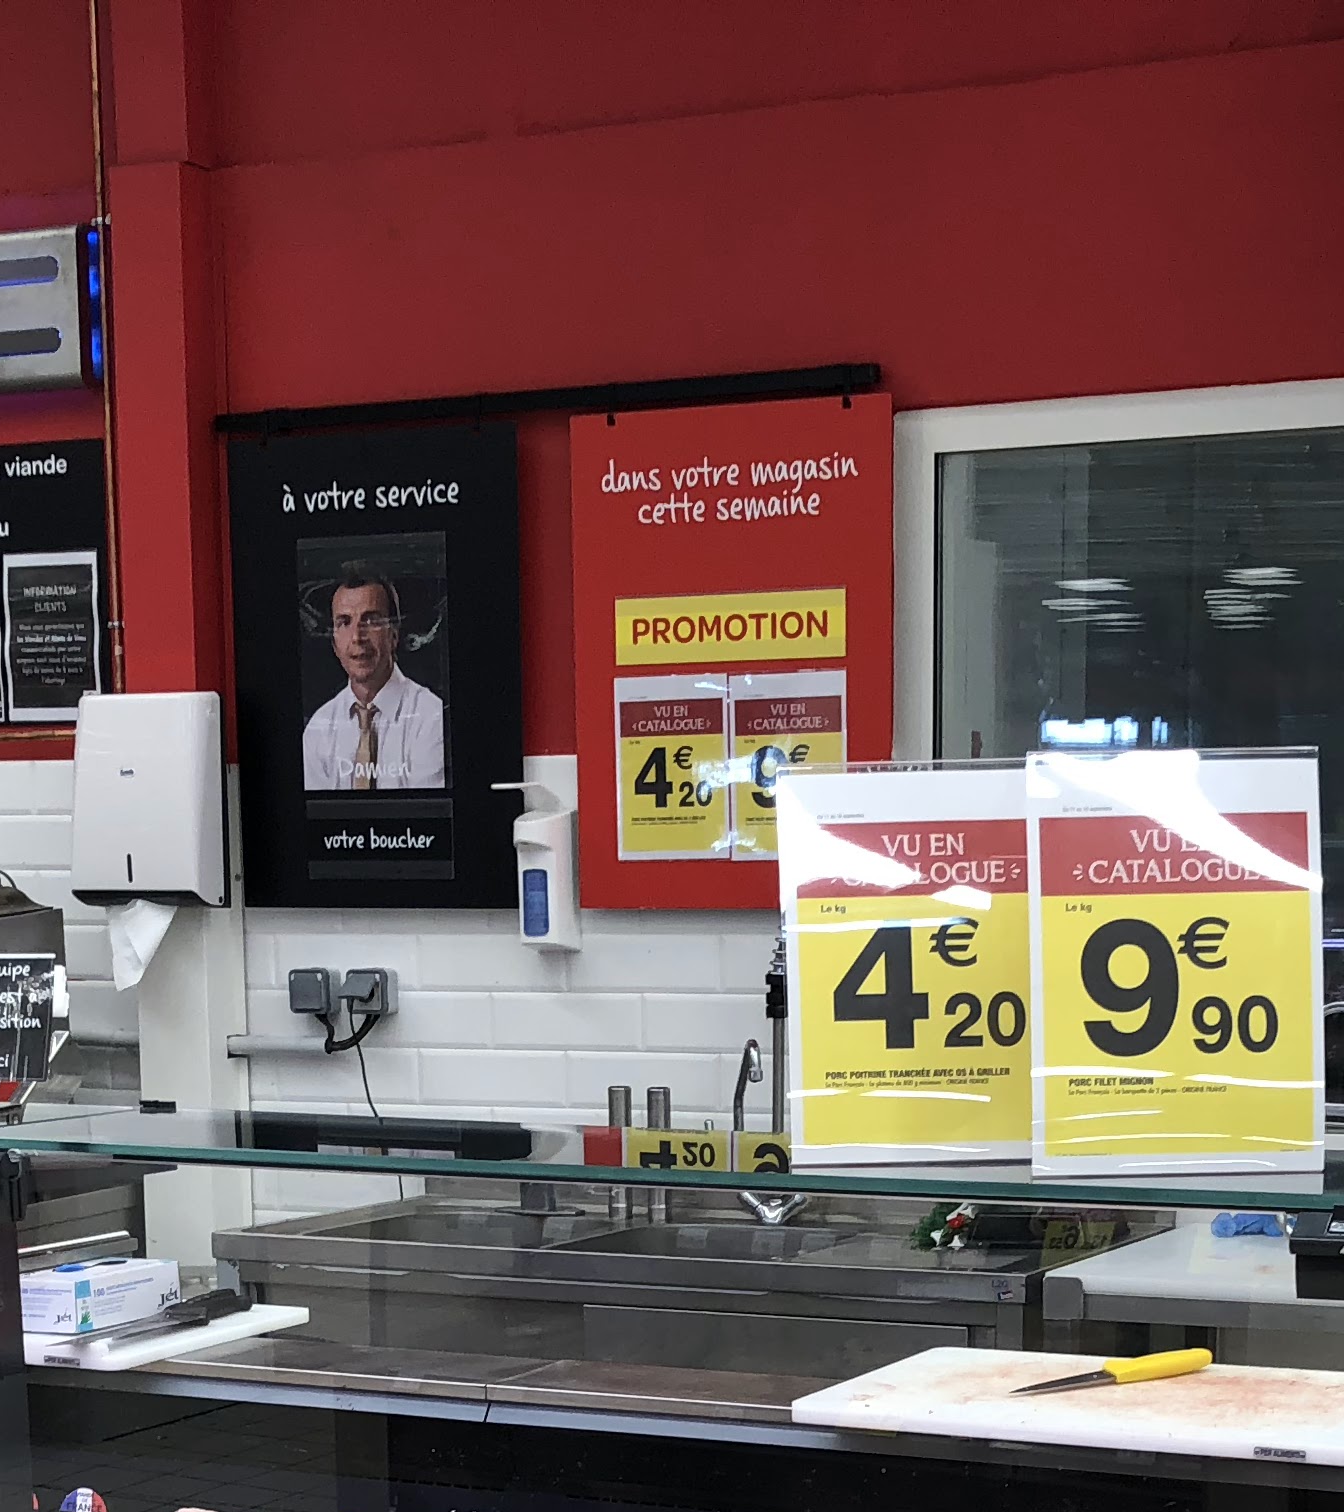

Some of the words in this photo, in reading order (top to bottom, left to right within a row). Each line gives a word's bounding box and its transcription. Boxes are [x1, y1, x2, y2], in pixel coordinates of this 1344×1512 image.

[5, 454, 68, 477] viande
[601, 459, 661, 493] dans
[671, 456, 740, 490] votre
[751, 451, 859, 494] magasin
[282, 484, 296, 513] à
[303, 480, 366, 513] votre
[375, 478, 459, 508] service
[637, 492, 705, 525] cette
[716, 490, 820, 521] semaine
[632, 609, 828, 645] PROMOTION
[654, 705, 672, 718] VU
[673, 704, 688, 717] EN
[770, 703, 789, 716] VU
[790, 702, 806, 715] EN
[638, 719, 705, 732] CATALOGUE
[753, 717, 823, 731] CATALOGUE
[323, 829, 365, 850] votre
[370, 826, 435, 850] boucher
[881, 834, 921, 857] VU
[929, 832, 965, 856] EN
[1130, 829, 1171, 853] VU
[843, 860, 1006, 887] LOGUE
[821, 904, 832, 913] Le
[835, 904, 846, 915] kg
[1065, 902, 1077, 912] Le
[1080, 902, 1092, 913] kg
[928, 916, 979, 967] €
[1177, 916, 1230, 970] €
[0, 987, 23, 1003] est
[833, 920, 930, 1050] 4
[1081, 918, 1180, 1057] 9
[943, 990, 1026, 1049] 20
[1192, 995, 1278, 1054] 90
[825, 1071, 847, 1080] PORC
[850, 1070, 887, 1079] POITRINE
[889, 1067, 931, 1078] TRANCHÉE
[933, 1068, 954, 1078] AVEC
[1069, 1078, 1091, 1086] PORC
[1094, 1077, 1117, 1086] FILET
